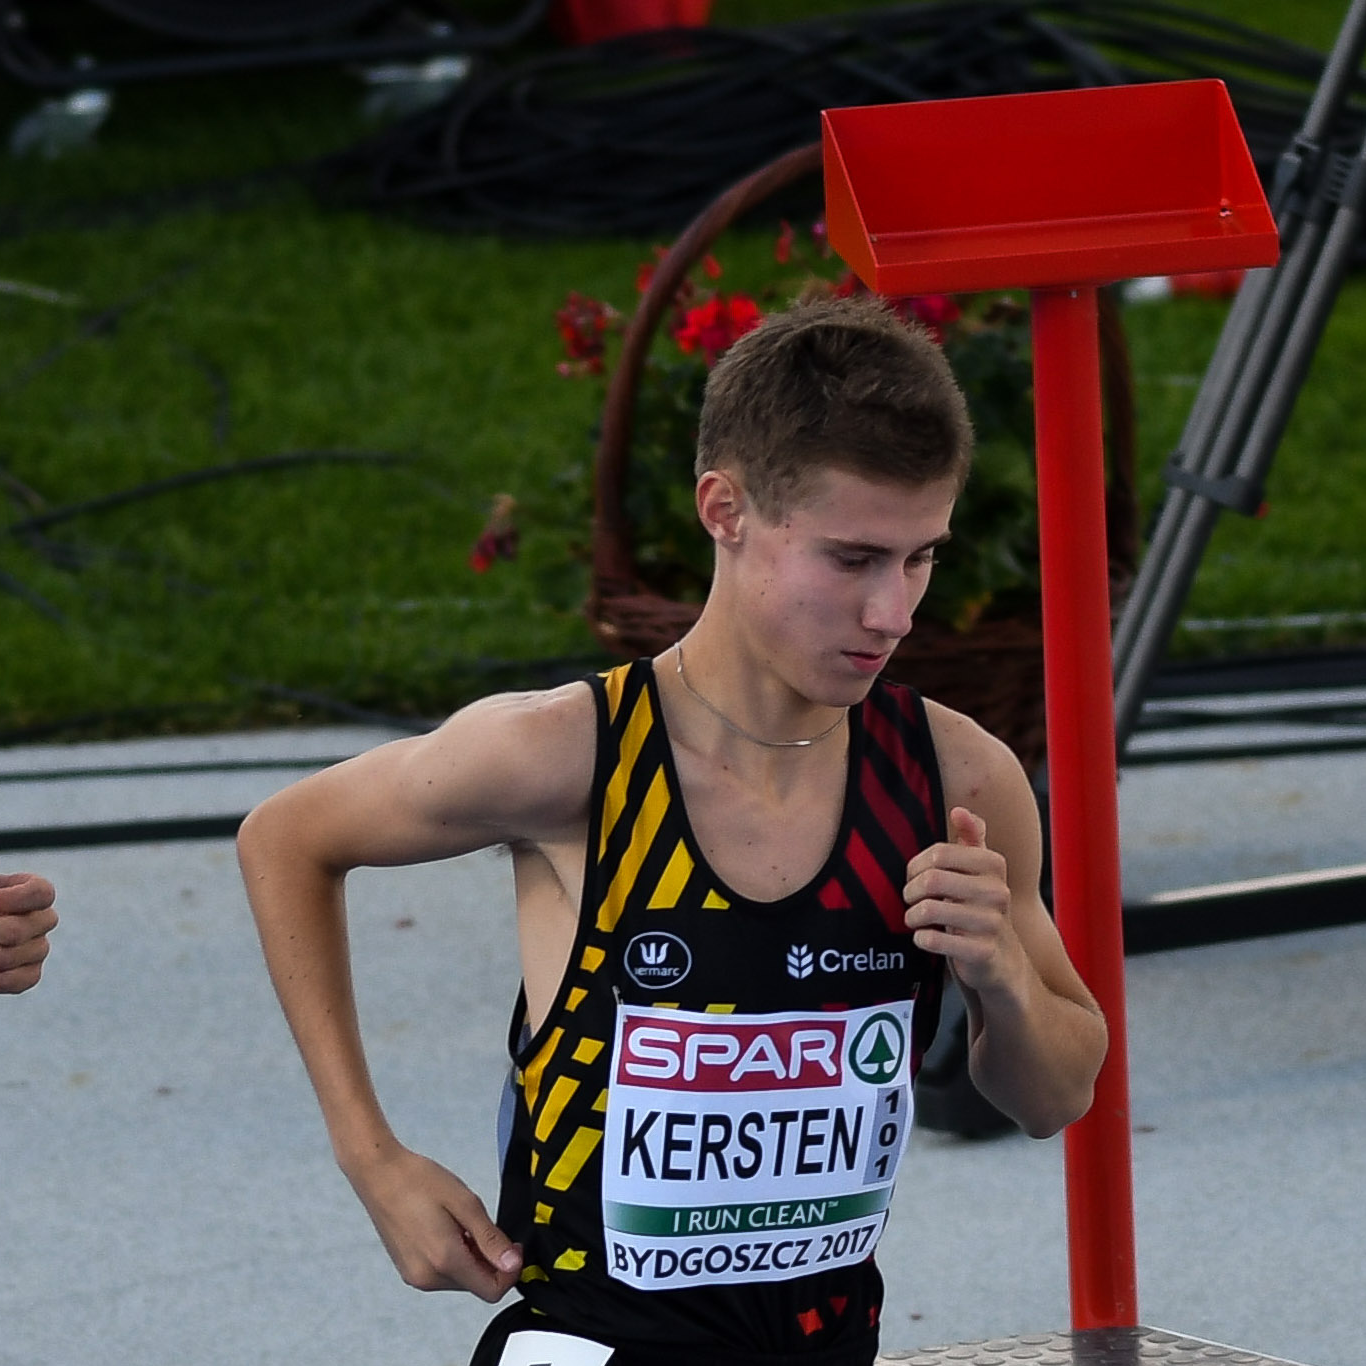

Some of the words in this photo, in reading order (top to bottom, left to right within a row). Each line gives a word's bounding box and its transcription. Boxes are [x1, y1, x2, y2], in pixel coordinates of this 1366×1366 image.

[819, 948, 905, 973] Crelan
[625, 1026, 838, 1082] SPAR
[621, 1105, 864, 1182] KERSTEN
[673, 1211, 680, 1232] I
[688, 1207, 741, 1232] RUN
[613, 1239, 813, 1279] BYDGOSZCZ
[816, 1223, 877, 1263] 2017
